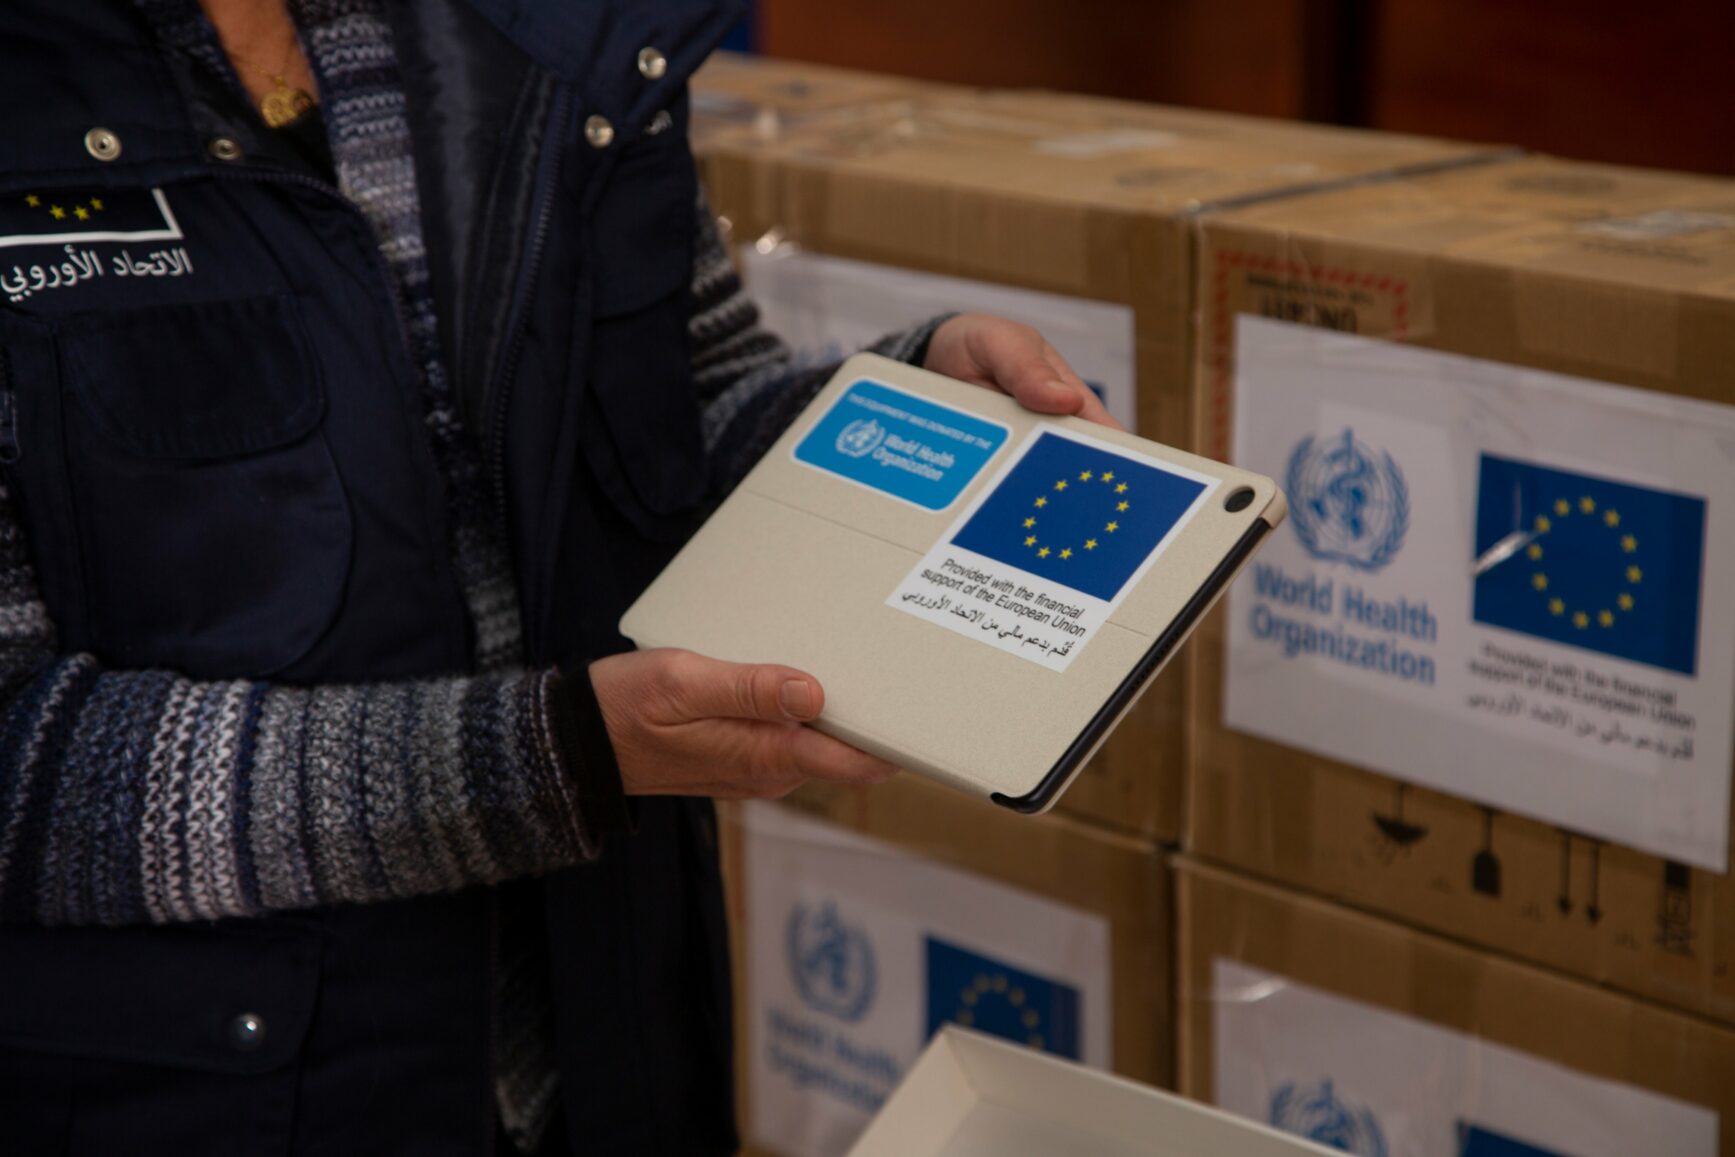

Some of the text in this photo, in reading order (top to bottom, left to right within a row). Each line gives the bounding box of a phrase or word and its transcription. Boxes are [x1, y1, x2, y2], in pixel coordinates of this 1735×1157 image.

[0, 244, 193, 302] الاتحاد الأوروبي
[872, 446, 944, 481] Organization
[885, 433, 955, 468] World Health
[921, 569, 1087, 637] support of the European Union
[941, 558, 1086, 620] Provided with the financial
[1253, 561, 1438, 644] World Health
[950, 604, 986, 622] الاتحاد
[981, 619, 999, 631] من
[998, 624, 1024, 639] مالي
[1249, 603, 1437, 687] Organization
